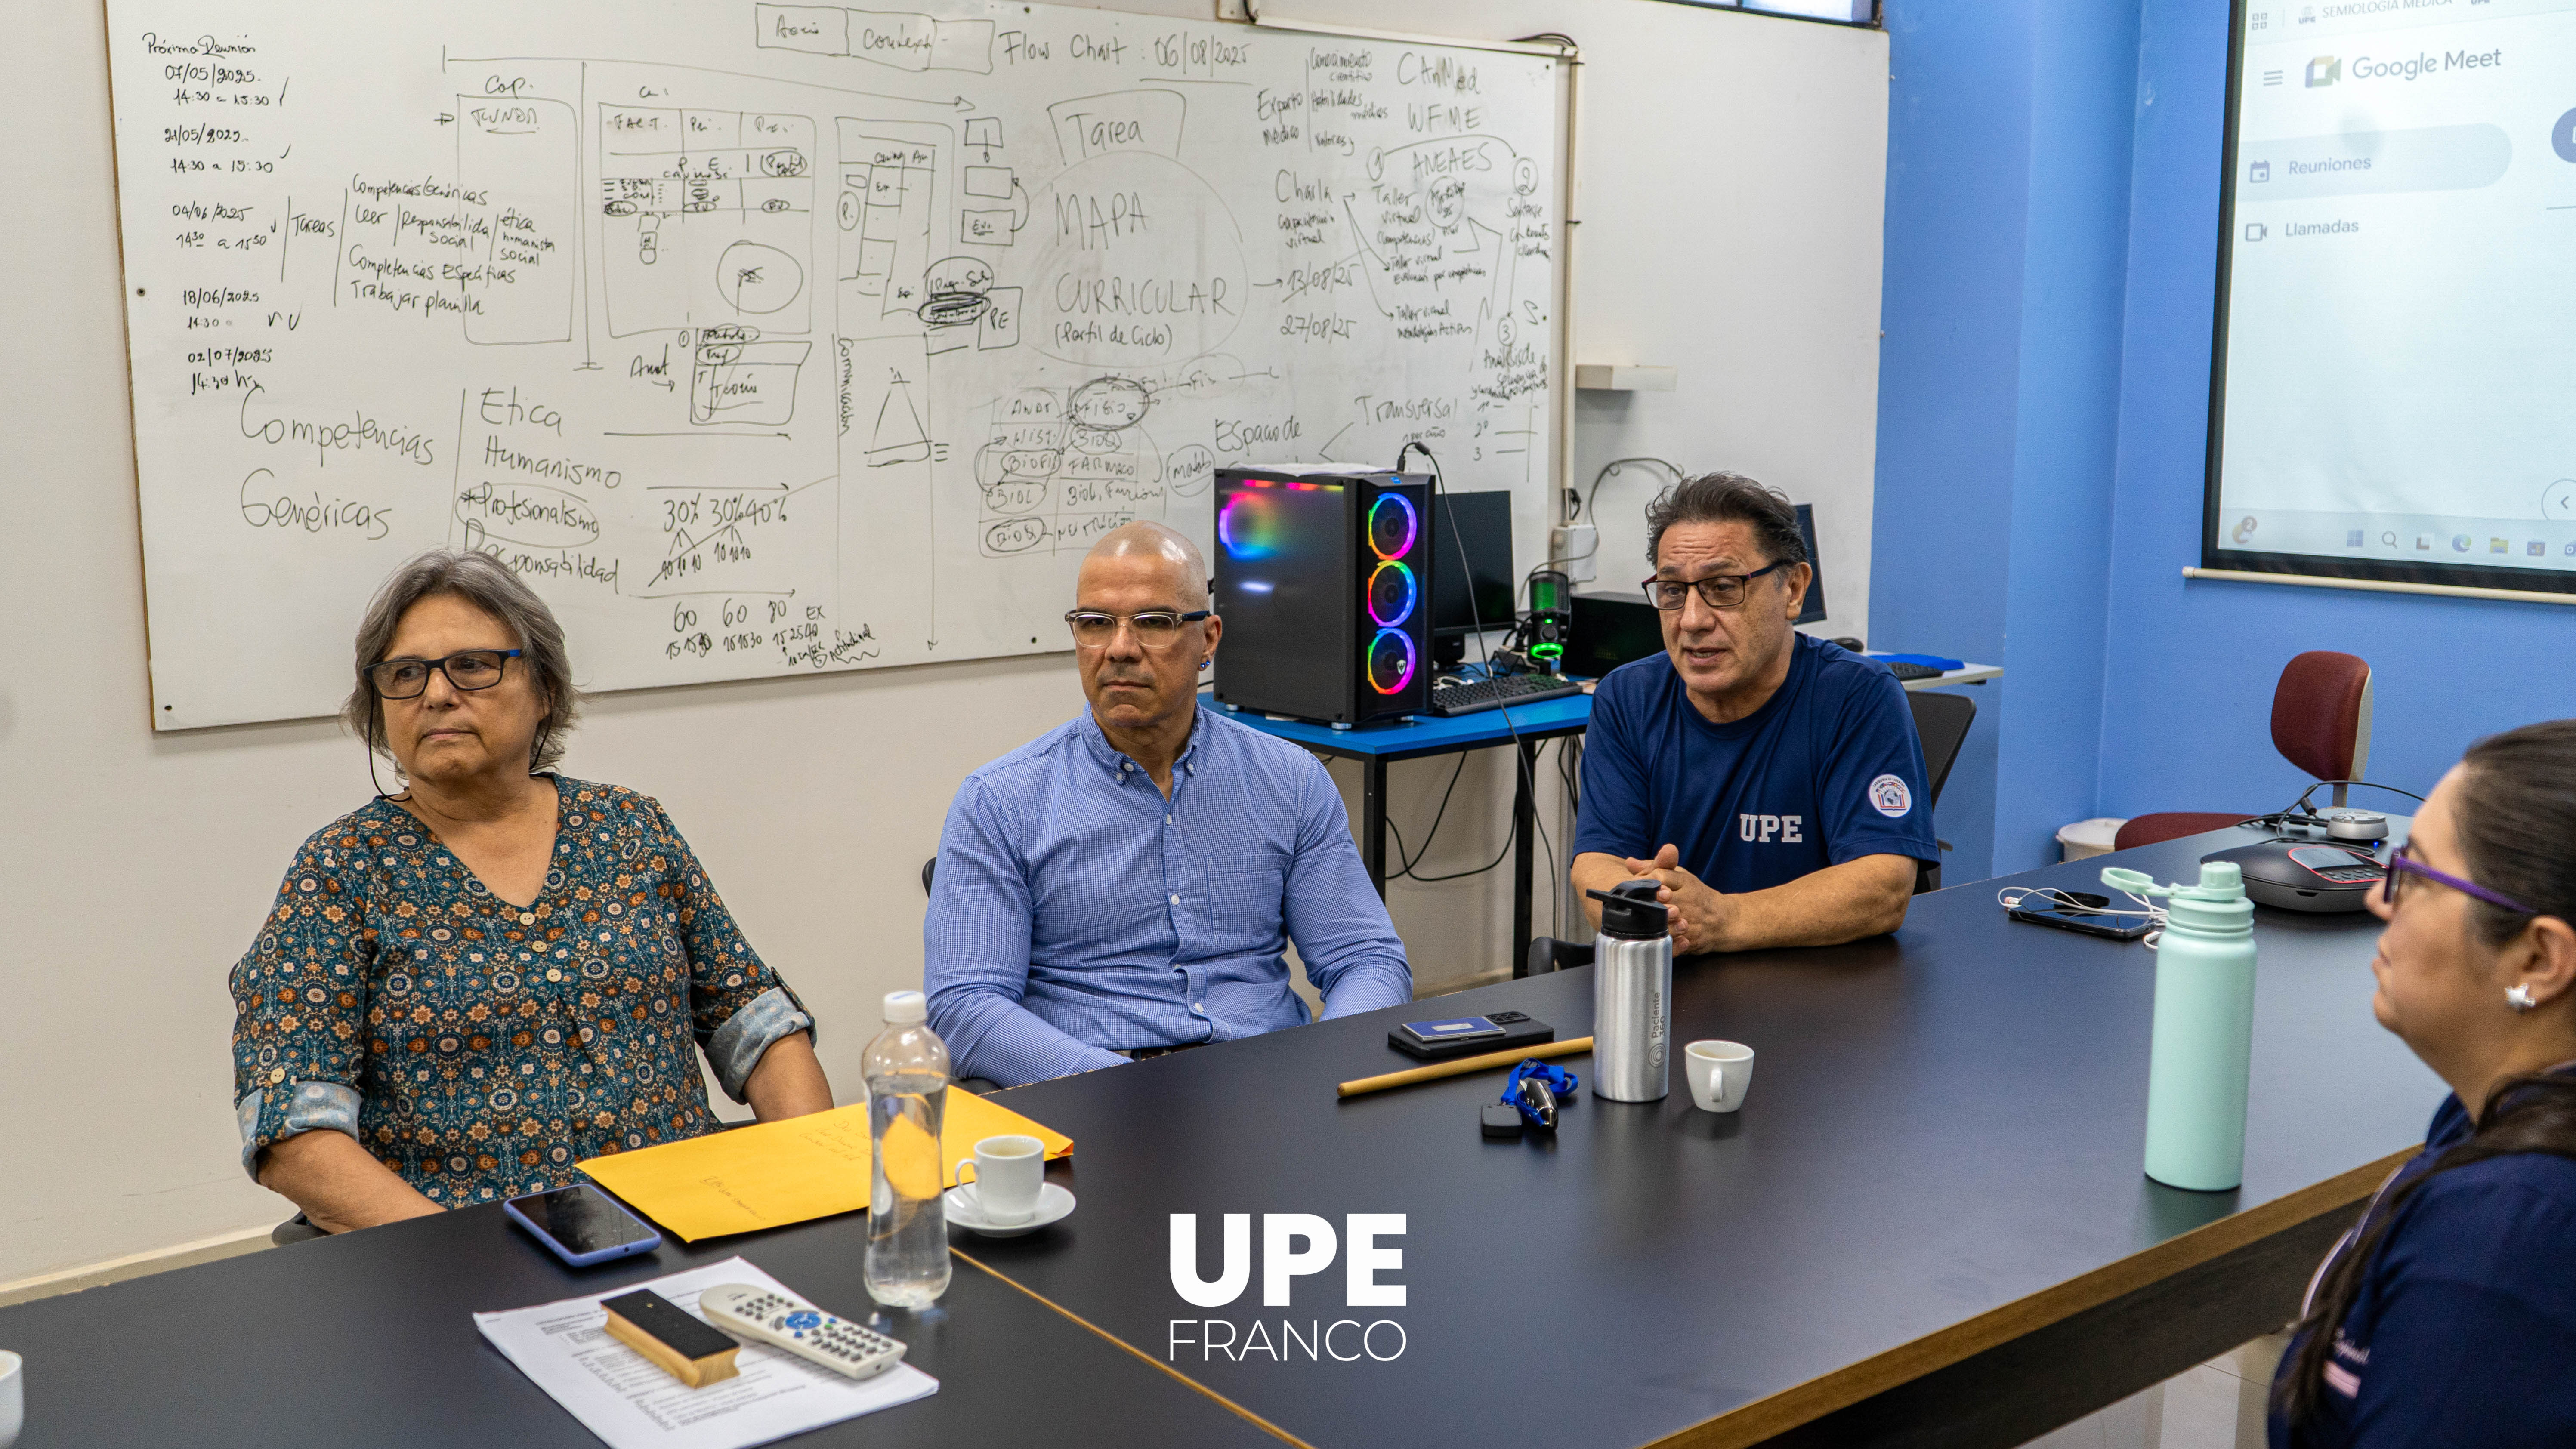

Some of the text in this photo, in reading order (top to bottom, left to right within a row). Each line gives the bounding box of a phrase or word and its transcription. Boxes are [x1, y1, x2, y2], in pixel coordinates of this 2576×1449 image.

[998, 31, 1049, 65] Flow
[2353, 49, 2502, 82] Google Meet
[1408, 102, 1482, 132] WFME
[1065, 113, 1145, 159] Tarea
[1413, 142, 1492, 177] ANEAES
[2289, 156, 2372, 175] Reuniones
[1276, 169, 1333, 203] Charla
[1056, 191, 1150, 250] MAPA
[2285, 219, 2359, 237] Llamadas
[1056, 273, 1235, 315] CURRICULAR
[1280, 312, 1357, 344] 27/08/25
[241, 385, 433, 467] Competencias
[1355, 394, 1457, 426] Transversal
[485, 434, 621, 489] Humanismo
[1740, 814, 1802, 842] UPE
[1652, 992, 1660, 1038] Paciente
